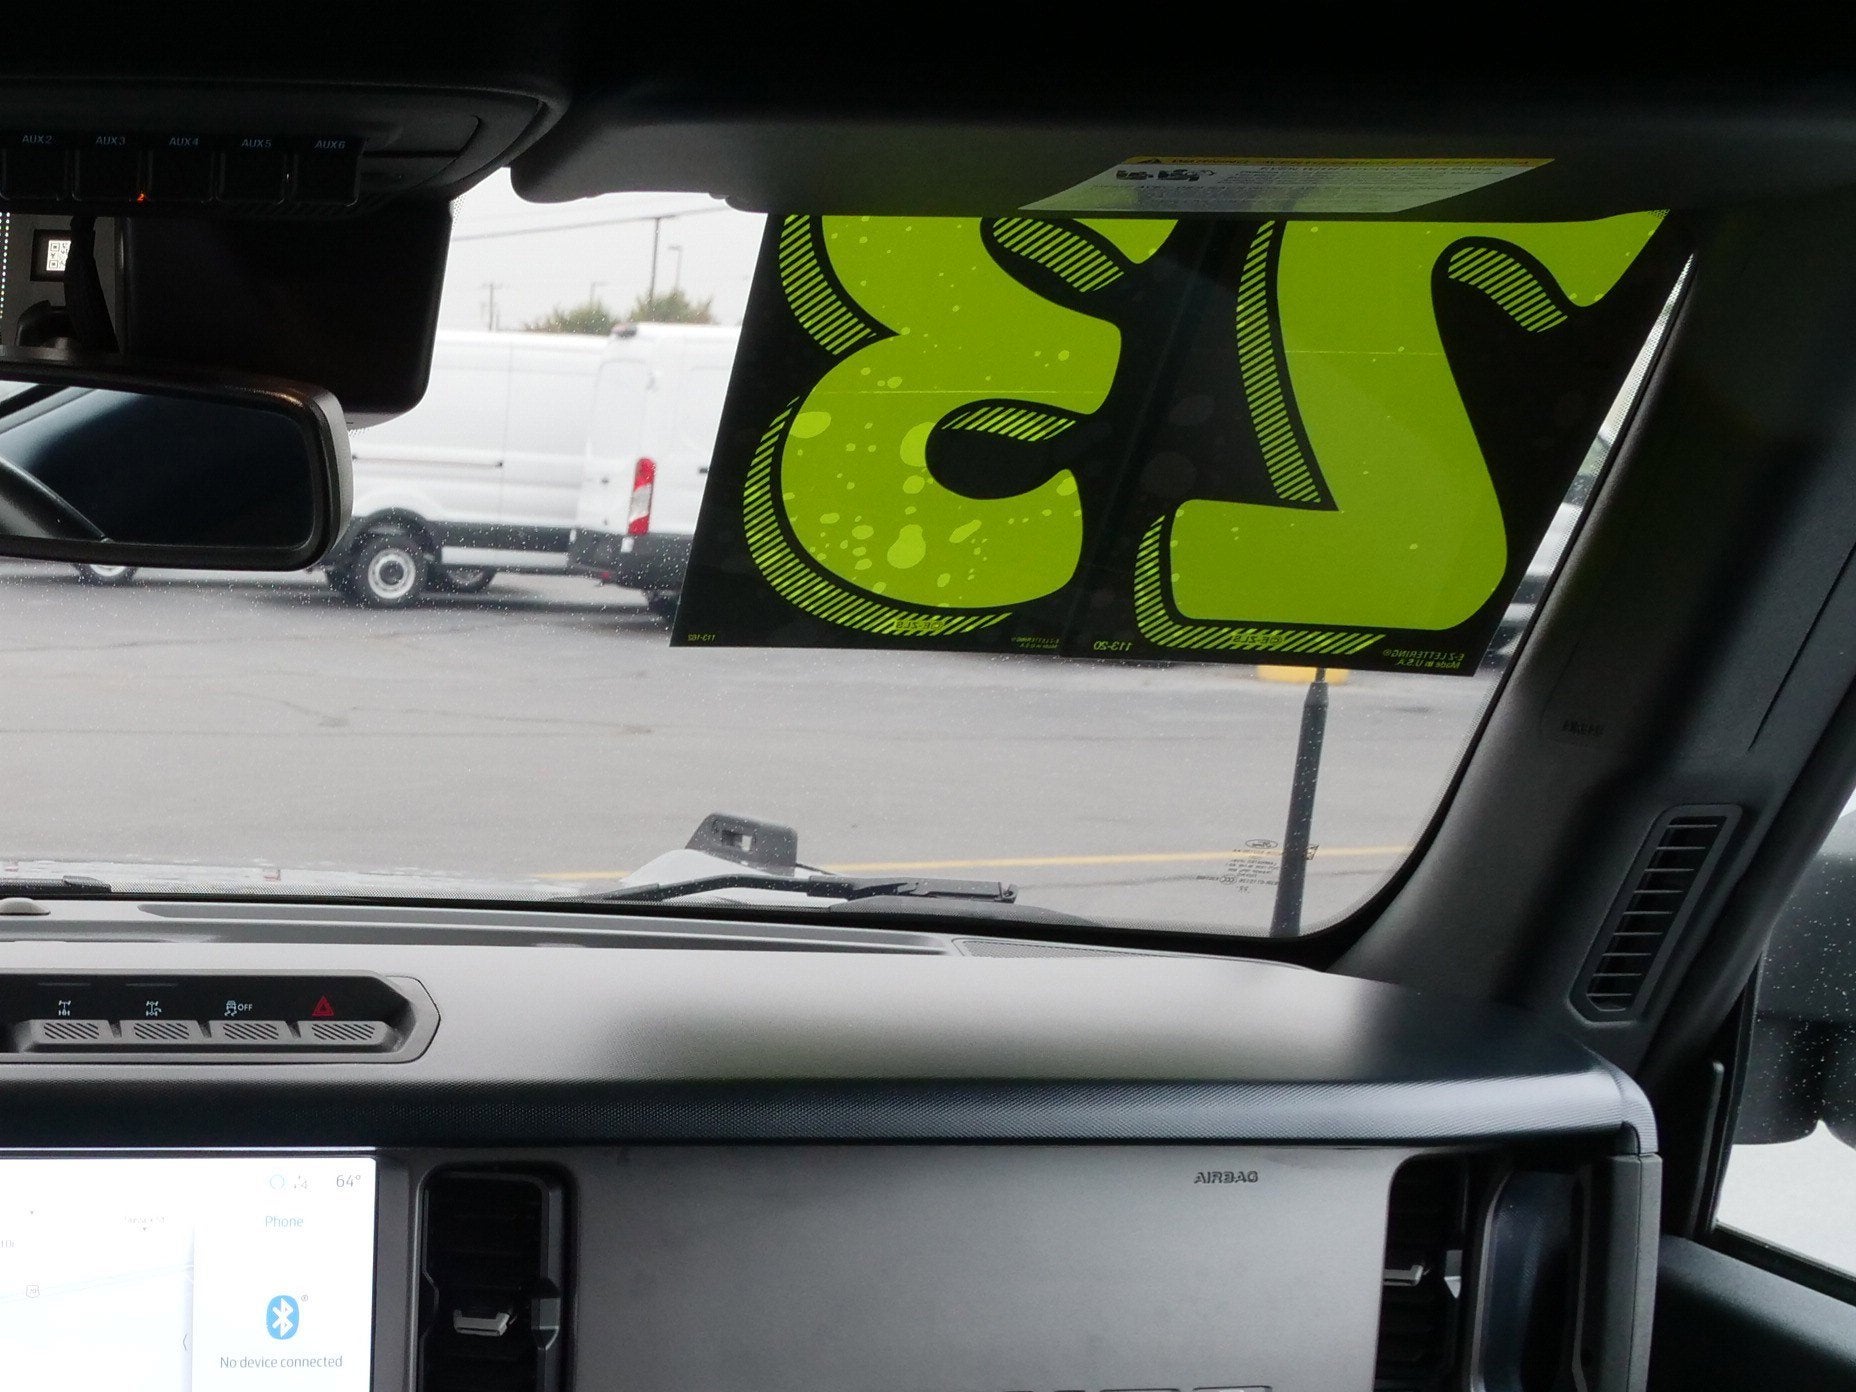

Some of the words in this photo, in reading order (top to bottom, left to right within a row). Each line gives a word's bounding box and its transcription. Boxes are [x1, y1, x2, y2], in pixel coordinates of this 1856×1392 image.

[22, 134, 44, 144] AUX
[95, 136, 118, 145] AUX
[169, 137, 191, 146] AUX
[242, 139, 264, 148] AUX
[314, 140, 337, 149] AUX
[237, 1004, 253, 1013] OFF
[335, 1174, 362, 1188] 64°
[1193, 1170, 1259, 1184] AIRBAG
[265, 1216, 304, 1230] Phone
[220, 1356, 236, 1368] No
[239, 1355, 277, 1368] device
[280, 1355, 343, 1368] connected
